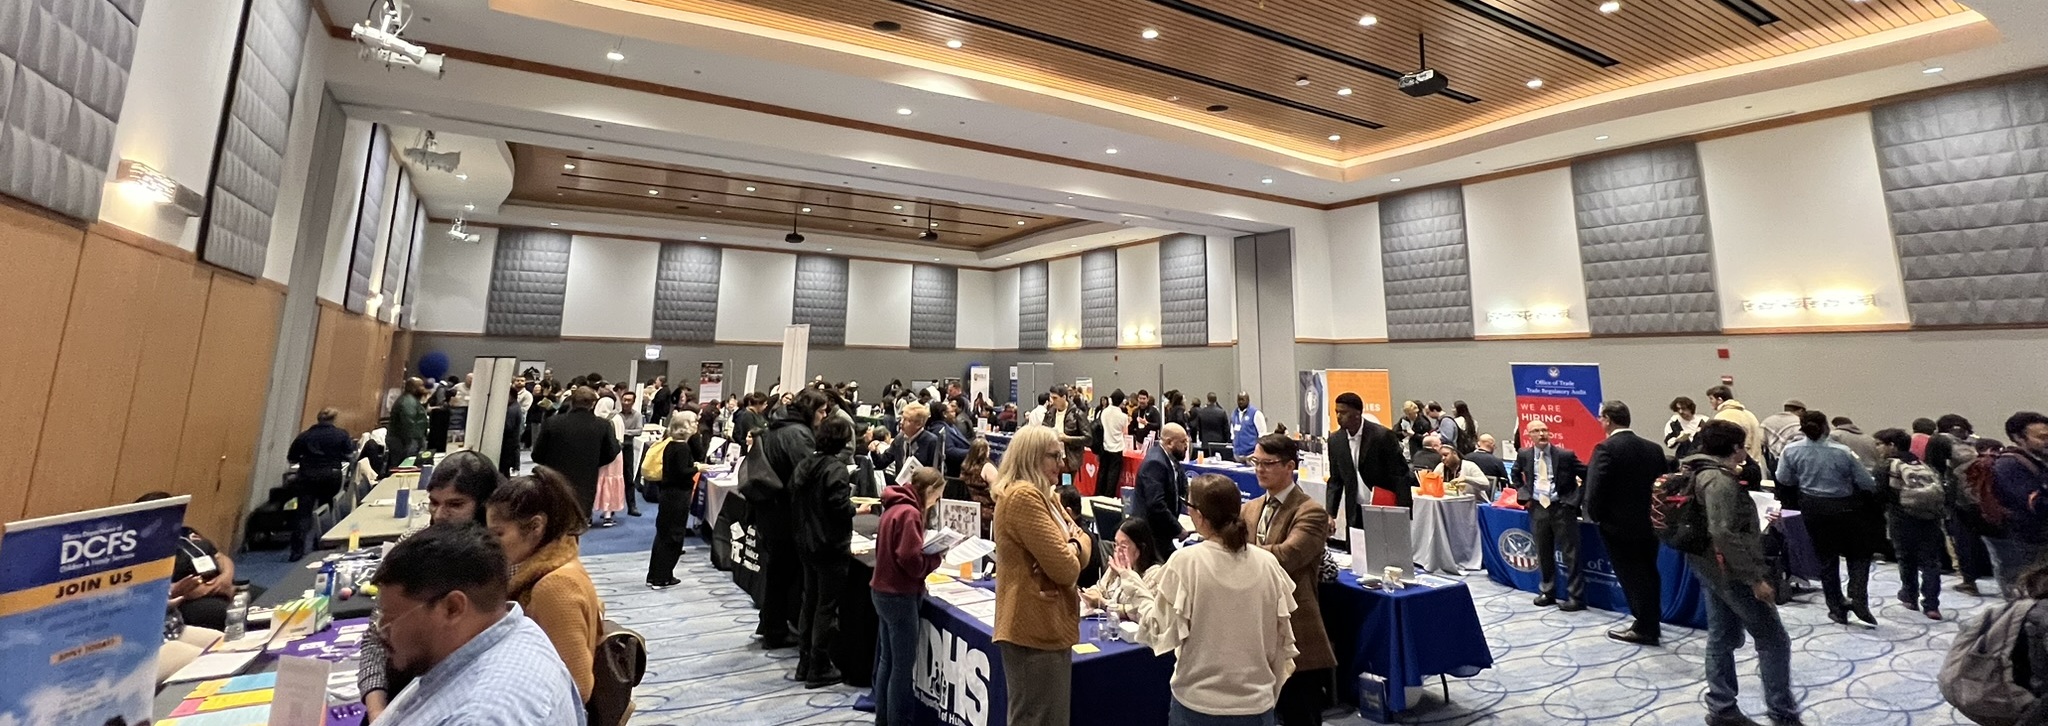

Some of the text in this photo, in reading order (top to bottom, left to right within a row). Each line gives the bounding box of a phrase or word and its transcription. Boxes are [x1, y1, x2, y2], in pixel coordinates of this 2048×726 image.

[1520, 403, 1561, 412] WE ARE
[1521, 413, 1563, 423] HIRING
[60, 529, 137, 565] DCFS
[1587, 558, 1605, 570] of
[55, 570, 133, 599] JOIN US
